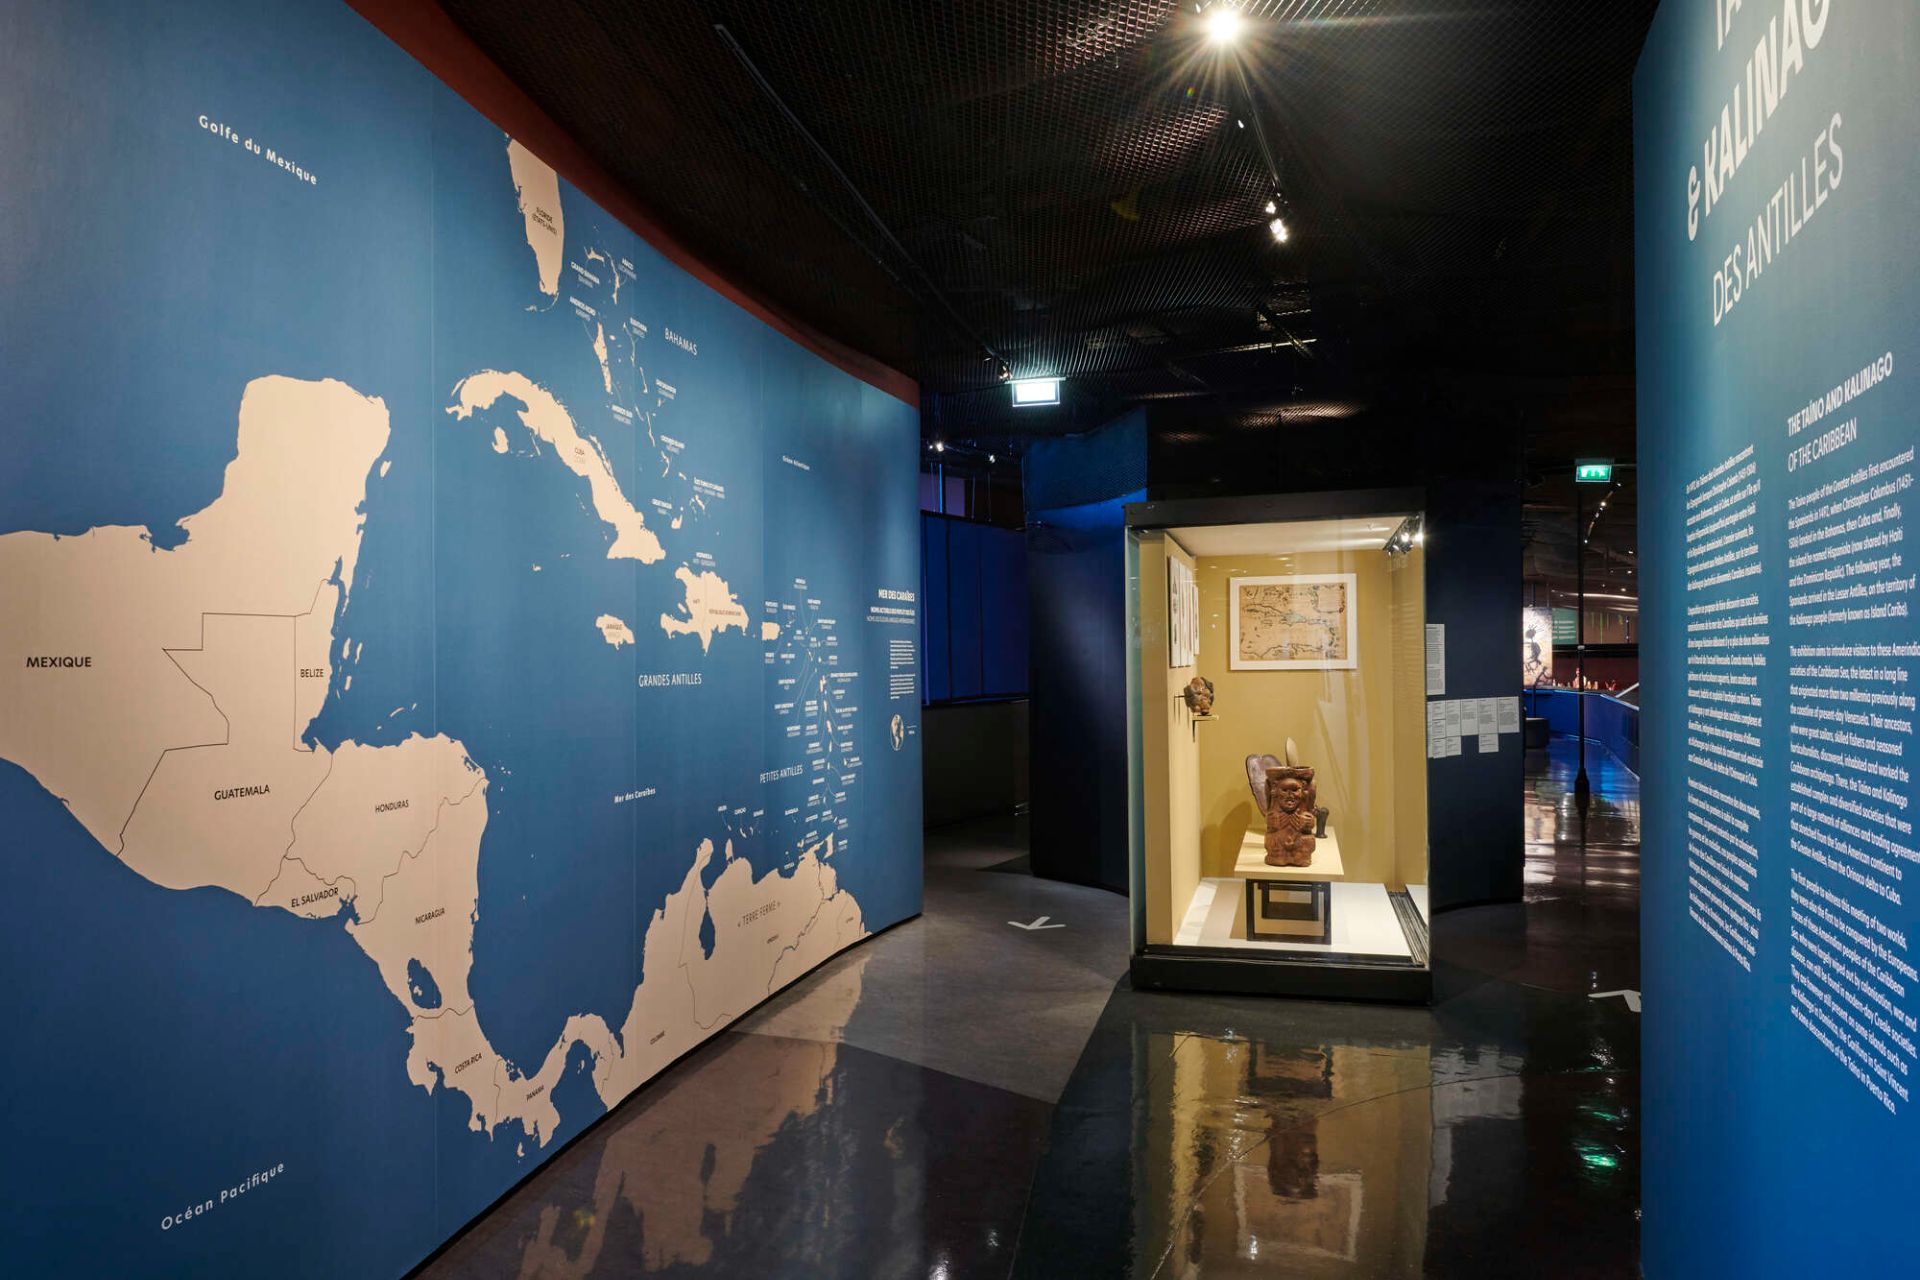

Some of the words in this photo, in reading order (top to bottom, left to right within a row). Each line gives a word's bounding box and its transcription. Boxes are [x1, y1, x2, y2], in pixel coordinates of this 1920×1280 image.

[198, 115, 239, 144] Golfe
[244, 138, 260, 155] du
[266, 148, 317, 185] Mexique
[1713, 243, 1741, 327] DES
[1746, 112, 1844, 289] ANTILLES
[664, 327, 698, 356] BAHAMAS
[1788, 416, 1800, 437] THE
[1800, 400, 1824, 430] TAÍNO
[1826, 385, 1843, 414] AND
[1844, 351, 1893, 404] KALINAGO
[1788, 451, 1797, 473] OF
[1798, 444, 1811, 467] THE
[1812, 417, 1857, 460] CARIBBEAN
[1879, 445, 1913, 473] encountered
[1870, 481, 1895, 501] Columbus
[1876, 579, 1884, 594] the
[1885, 577, 1907, 593] territory
[1908, 573, 1915, 589] of
[1870, 603, 1886, 618] Island
[1870, 644, 1875, 656] to
[26, 656, 92, 668] MEXIQUE
[300, 668, 324, 678] BELIZE
[638, 674, 670, 688] GRANDES
[671, 673, 702, 686] ANTILLES
[1884, 666, 1896, 684] long
[1876, 740, 1902, 756] seasoned
[760, 770, 779, 784] PETITES
[780, 764, 803, 779] ANTILLES
[1867, 761, 1877, 774] and
[1878, 763, 1898, 780] worked
[1899, 767, 1908, 783] the
[214, 784, 270, 800] GUATEMALA
[625, 791, 634, 801] des
[1872, 785, 1882, 799] and
[1883, 787, 1907, 809] Kalinago
[375, 800, 409, 814] HONDURAS
[1895, 866, 1901, 880] to
[291, 899, 300, 908] EL
[301, 887, 339, 905] SALVADOR
[415, 907, 446, 925] NICARAGUA
[1870, 915, 1875, 929] of
[1876, 966, 1904, 997] Caribbean
[1905, 1014, 1916, 1032] and
[455, 1060, 470, 1074] COSTA
[470, 1052, 482, 1065] RICA
[1900, 1061, 1907, 1075] as
[161, 1200, 214, 1230] Océan
[220, 1163, 284, 1203] Pacifique
